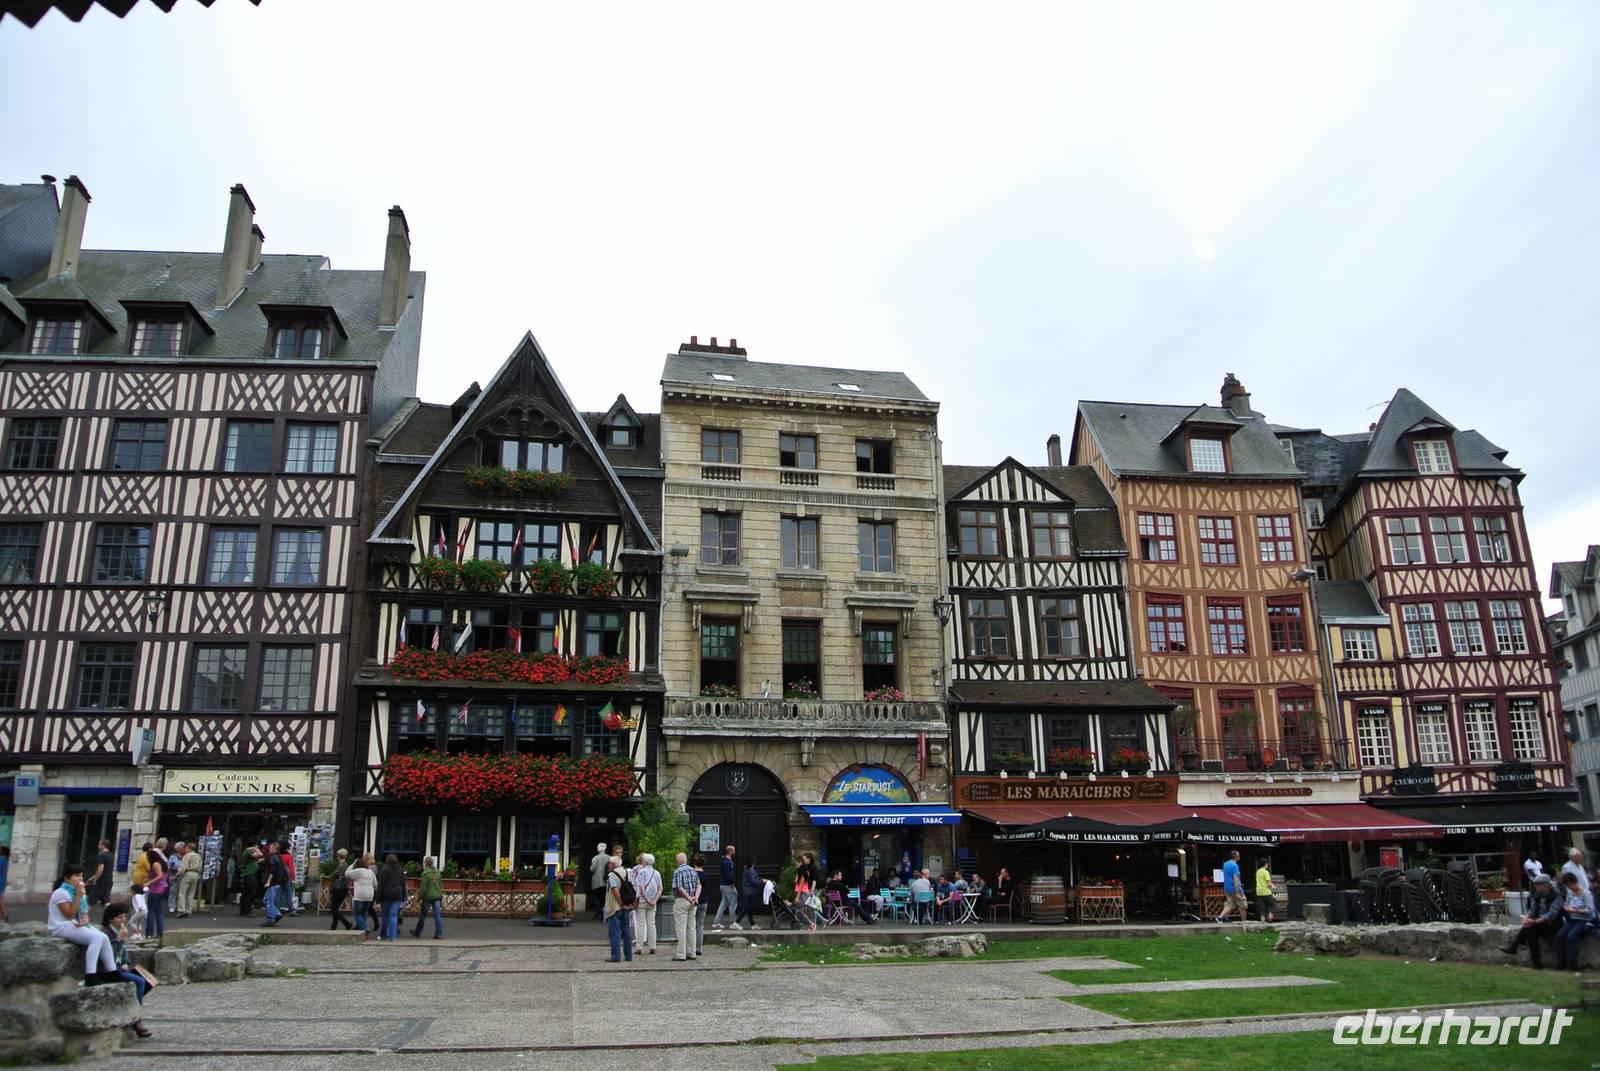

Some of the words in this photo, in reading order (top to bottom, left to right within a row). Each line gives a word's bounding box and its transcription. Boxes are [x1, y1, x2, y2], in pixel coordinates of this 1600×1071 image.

[217, 773, 260, 781] Cadeaux
[730, 771, 745, 783] 33
[179, 782, 296, 793] SOUVENIRS
[853, 781, 892, 792] STARDUST
[1007, 786, 1032, 799] LES
[1038, 785, 1131, 799] MARAICHERS
[1249, 788, 1304, 796] MAUPASSANT
[861, 817, 869, 825] LE
[871, 817, 905, 825] STARDUST
[1049, 832, 1066, 841] Depuis
[1097, 833, 1139, 841] MARAICHERS
